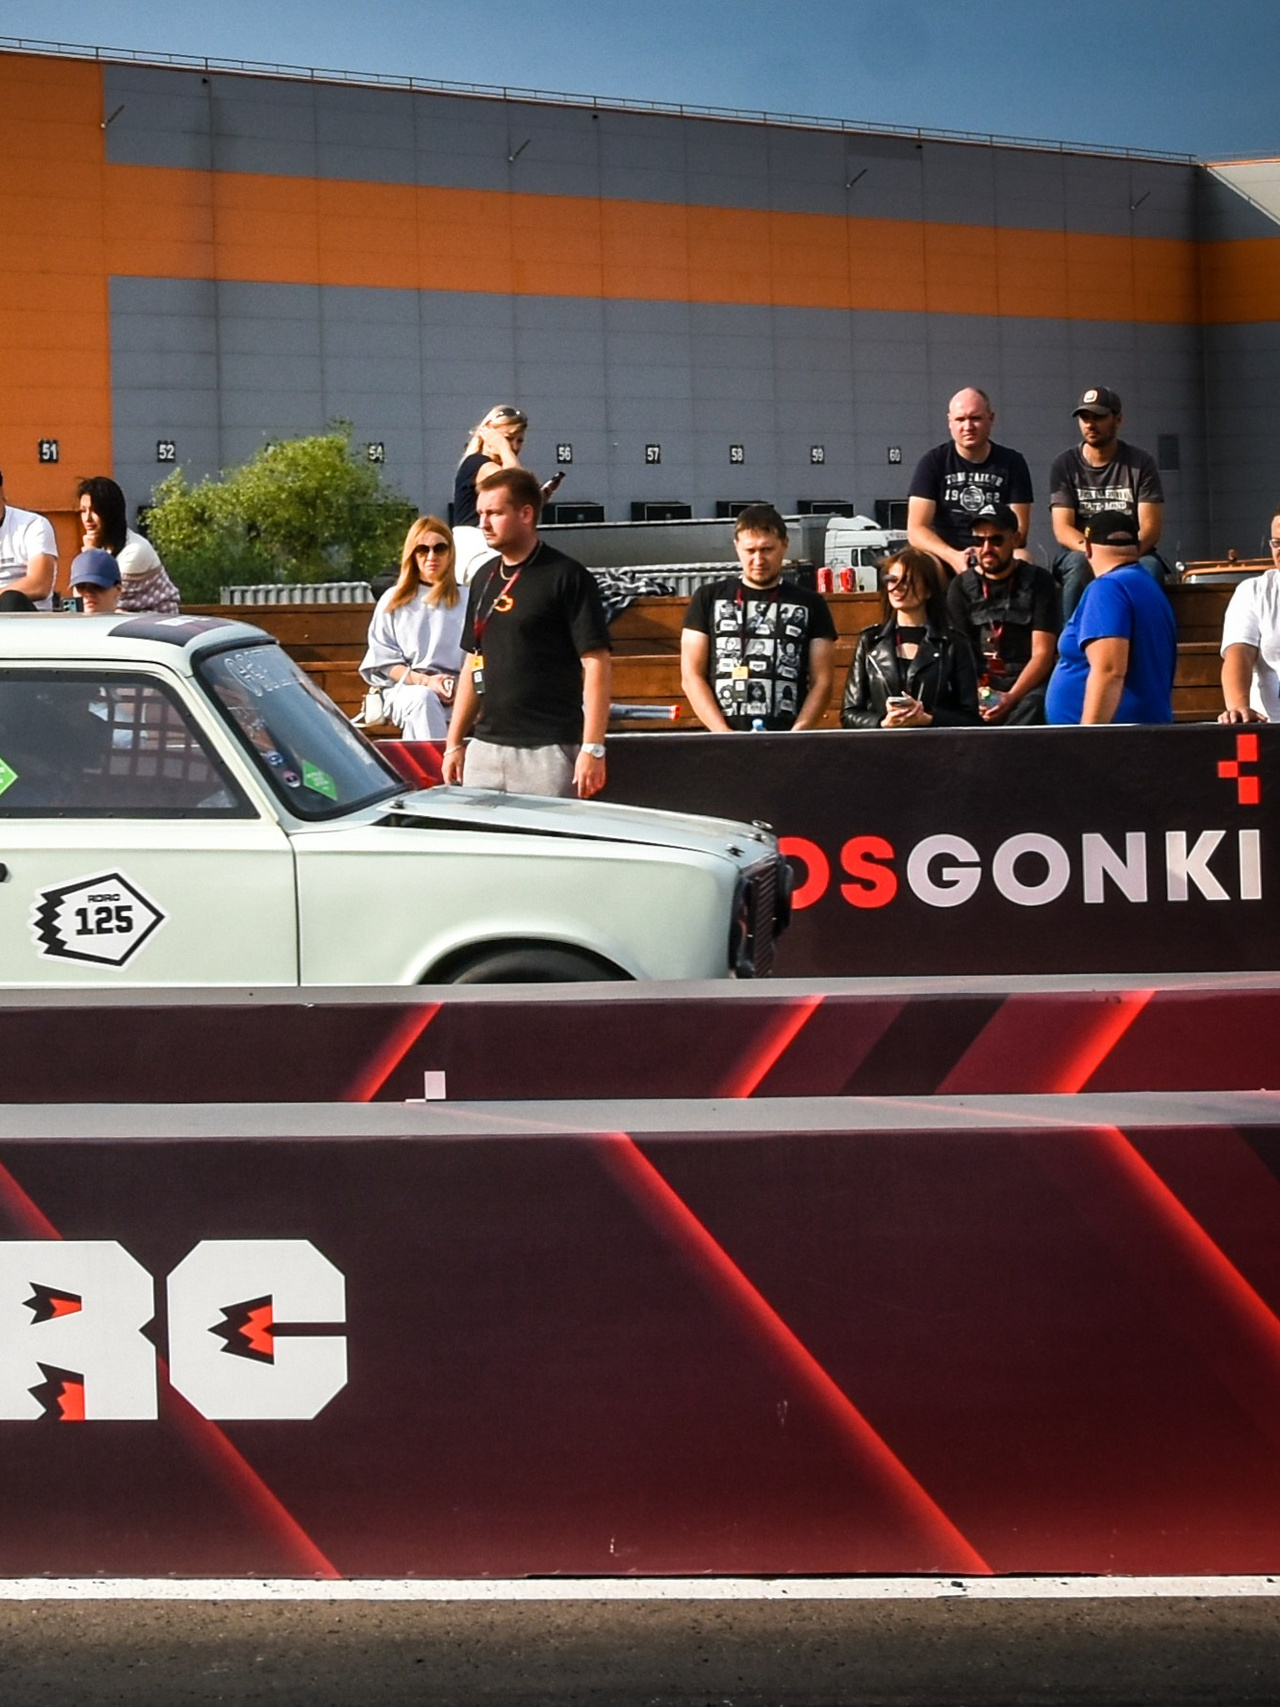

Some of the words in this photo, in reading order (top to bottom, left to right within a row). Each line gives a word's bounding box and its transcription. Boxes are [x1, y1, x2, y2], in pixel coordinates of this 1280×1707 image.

[42, 443, 57, 460] 51
[159, 444, 175, 459] 52
[368, 445, 384, 460] 54
[558, 446, 571, 461] 56
[647, 447, 659, 461] 57
[731, 447, 743, 461] 58
[812, 448, 824, 462] 59
[889, 449, 901, 462] 60
[945, 489, 959, 501] 19
[88, 893, 120, 903] RDRC
[75, 905, 133, 935] 125
